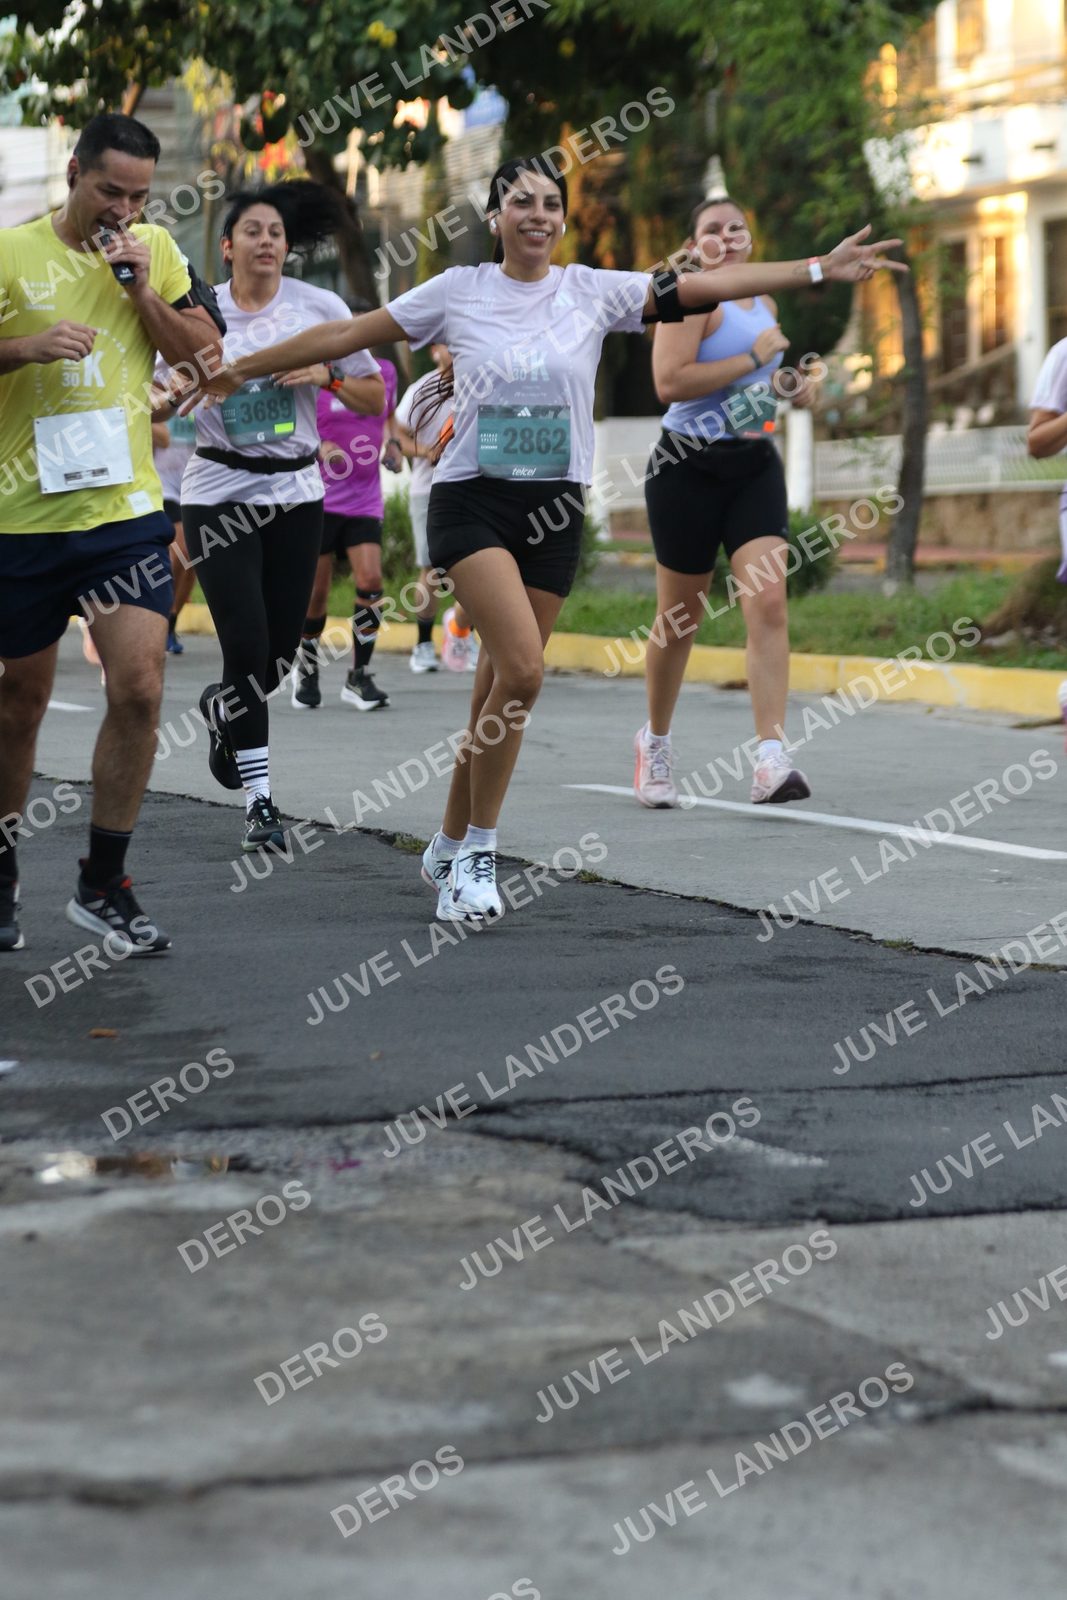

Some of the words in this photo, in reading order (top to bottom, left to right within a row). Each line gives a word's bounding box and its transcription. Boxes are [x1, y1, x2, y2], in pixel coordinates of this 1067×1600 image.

[62, 372, 80, 387] 30
[240, 397, 293, 425] 3689
[503, 427, 567, 455] 2862
[511, 467, 537, 476] telcel
